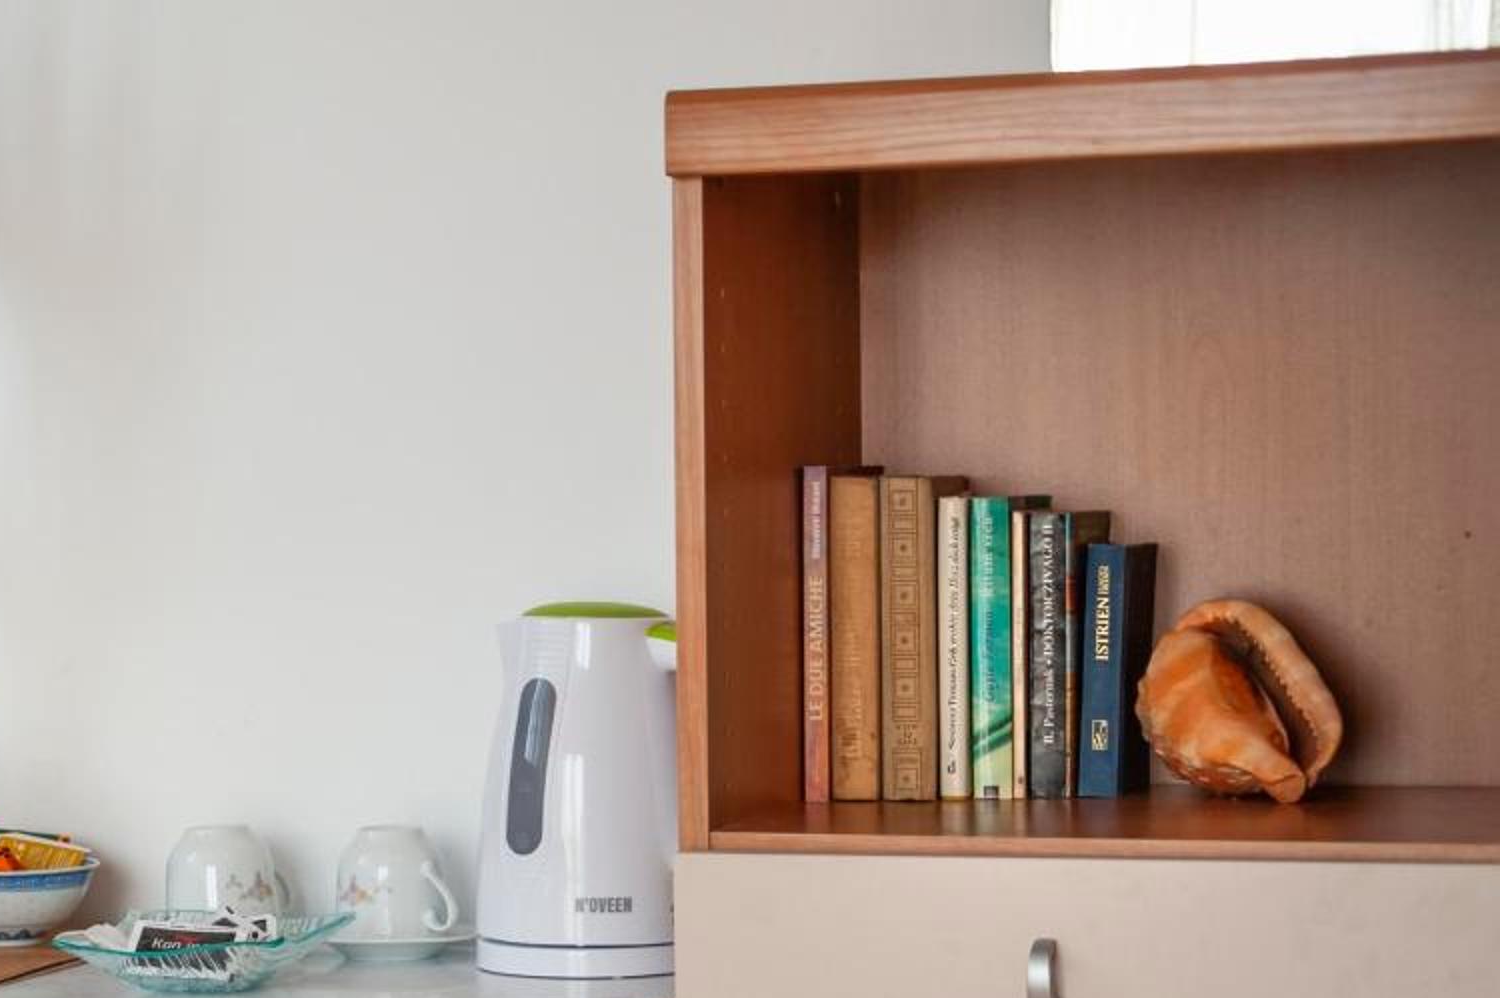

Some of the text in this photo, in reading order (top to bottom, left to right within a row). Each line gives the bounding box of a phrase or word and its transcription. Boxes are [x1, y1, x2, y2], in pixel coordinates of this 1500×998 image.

[809, 575, 823, 653] AMICHE
[1095, 597, 1109, 661] ISTRIEN
[809, 658, 823, 696] DUE
[809, 703, 823, 721] LE
[574, 896, 633, 913] N'OVEEN
